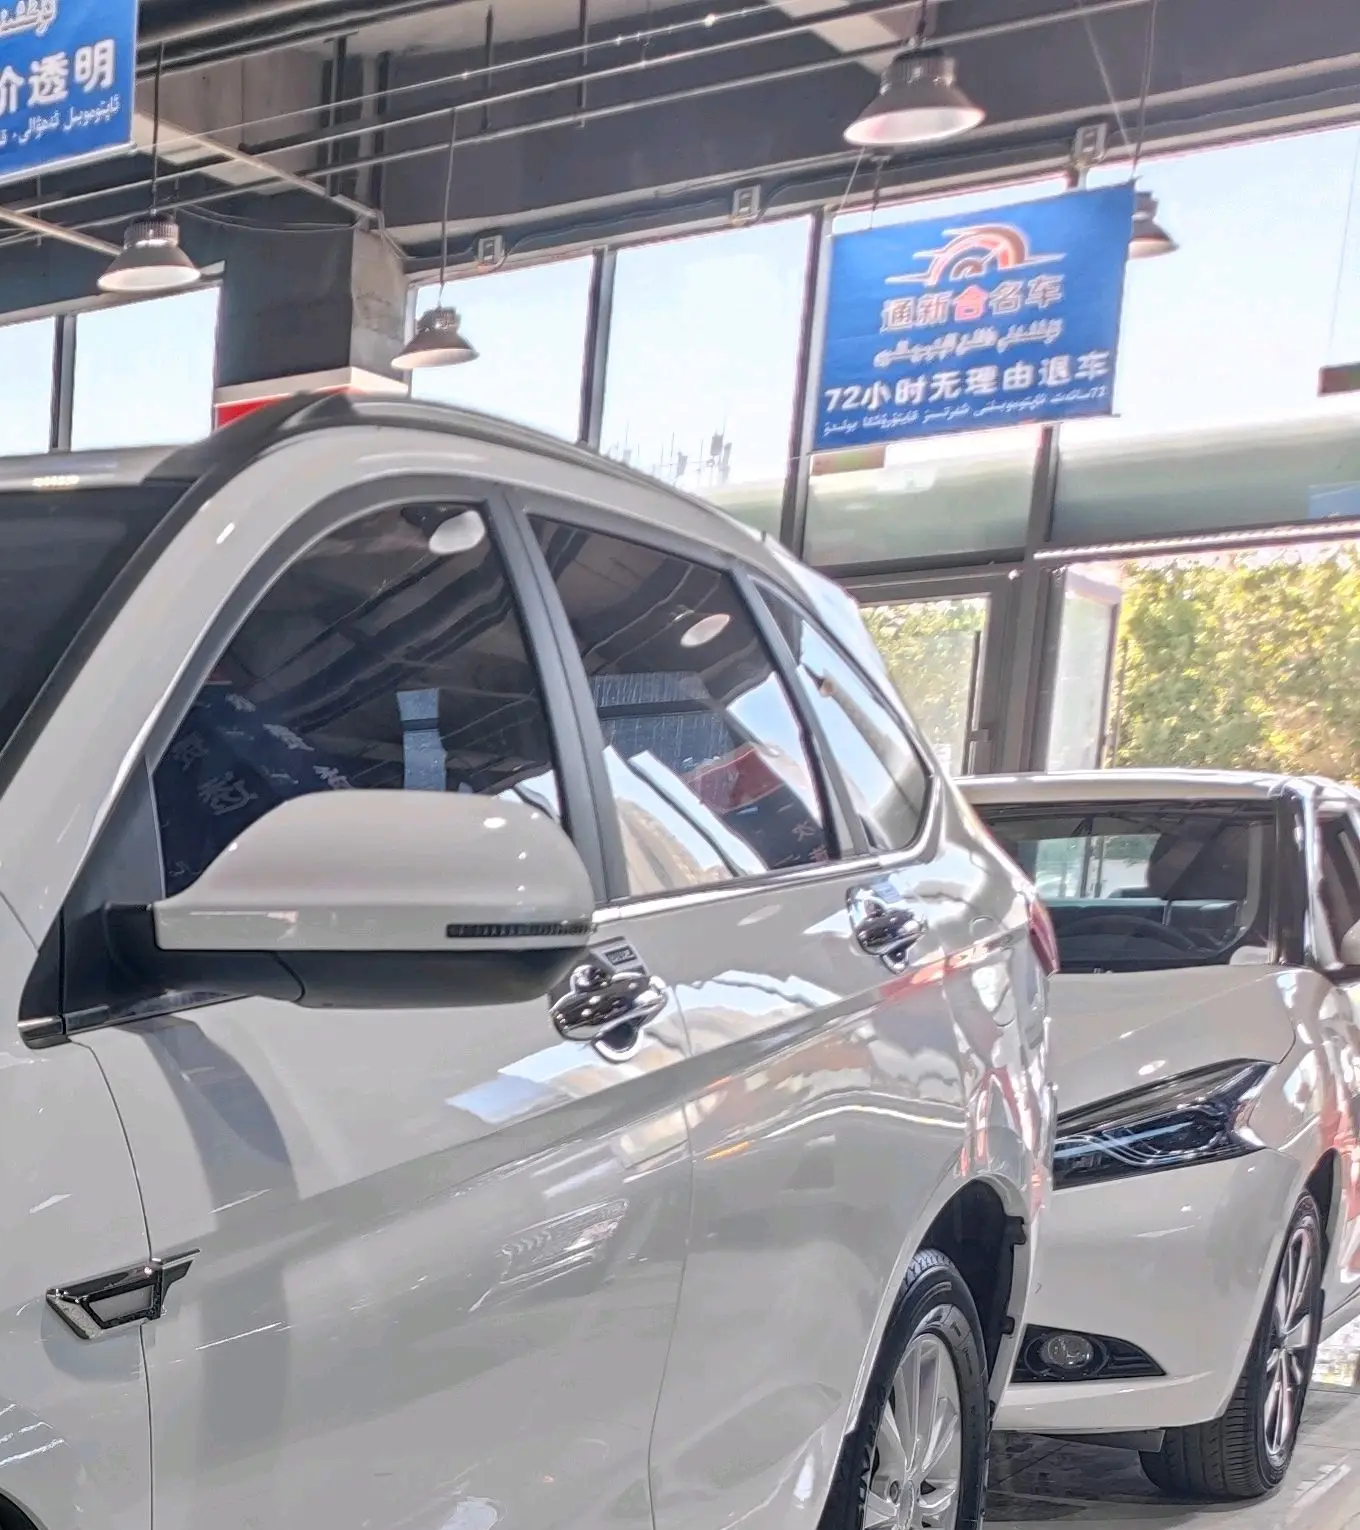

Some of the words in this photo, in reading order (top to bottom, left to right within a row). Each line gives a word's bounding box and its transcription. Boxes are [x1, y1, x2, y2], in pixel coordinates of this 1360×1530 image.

[882, 274, 1064, 333] 通新合名车
[825, 351, 1110, 413] 72小时无理由退车
